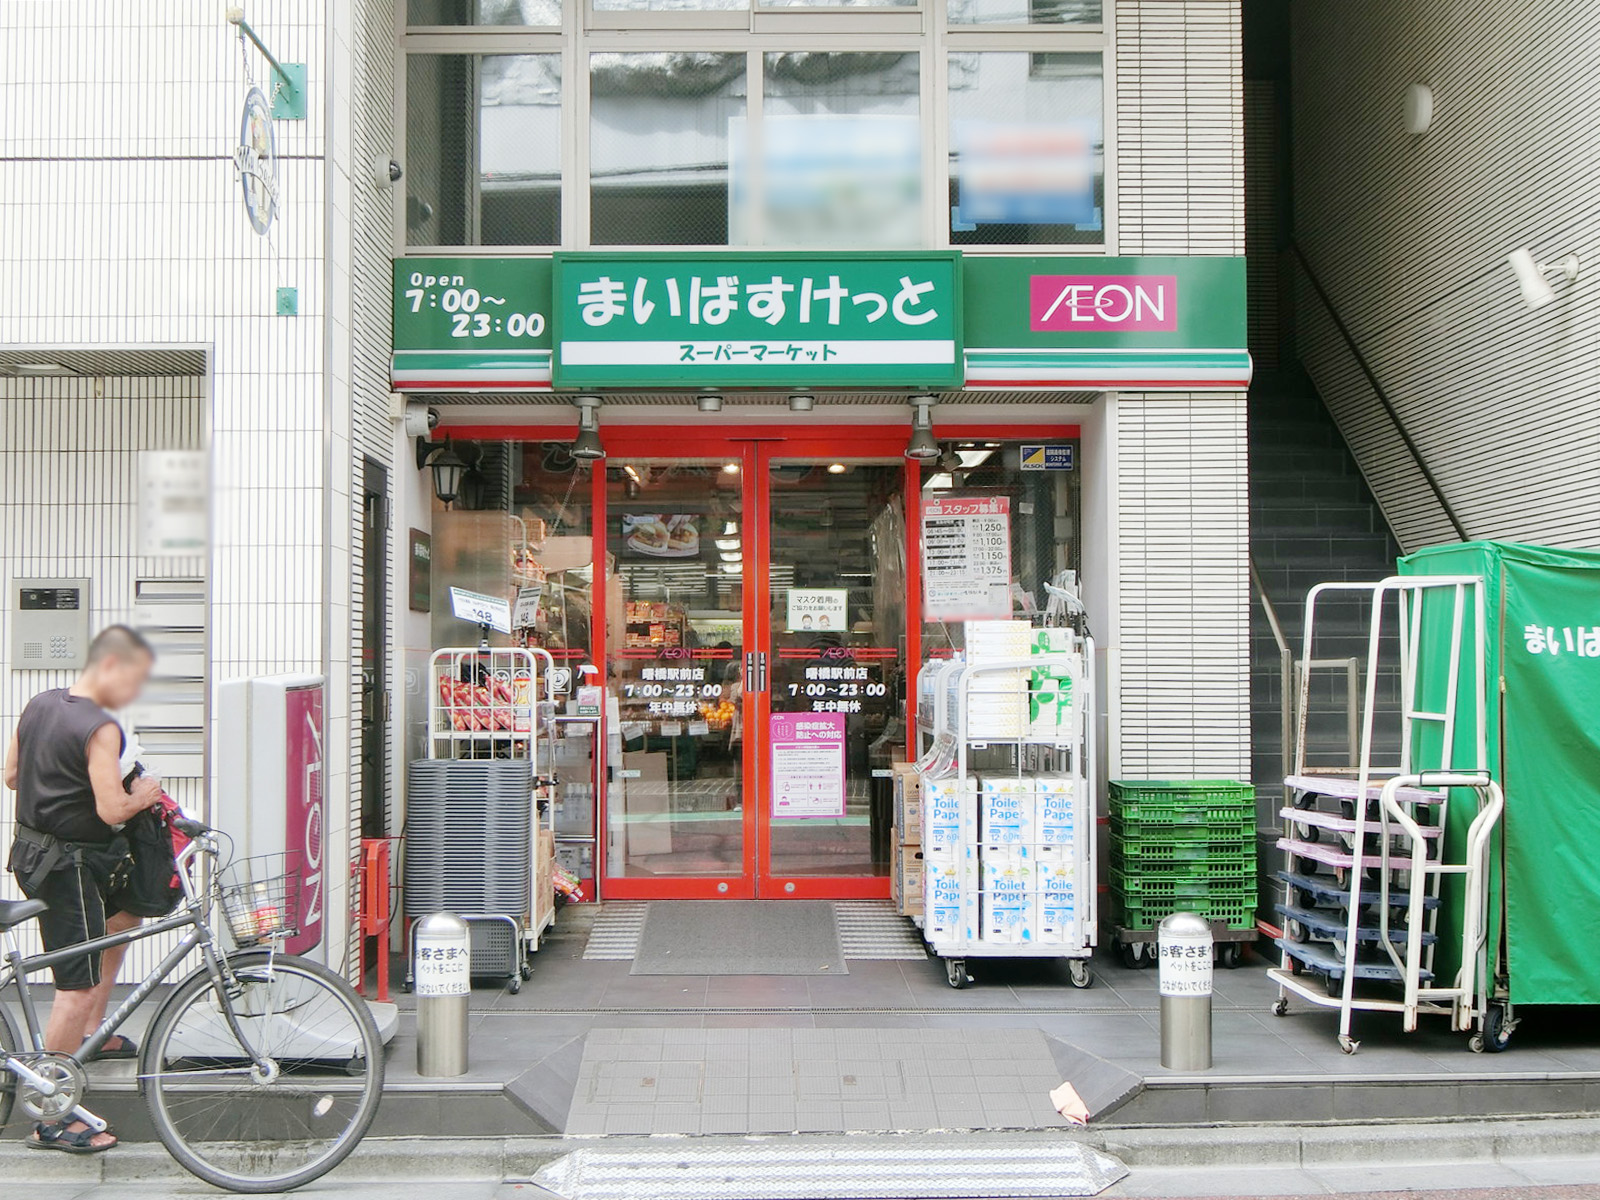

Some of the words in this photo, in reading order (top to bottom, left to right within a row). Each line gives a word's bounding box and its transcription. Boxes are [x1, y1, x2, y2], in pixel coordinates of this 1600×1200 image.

[410, 272, 464, 288] Open
[577, 275, 939, 326] まいばすけっと
[451, 313, 545, 337] 23:00
[679, 344, 838, 362] スーパーマーケット
[649, 701, 698, 714] 年中無休
[812, 700, 861, 713] 年中無休
[993, 879, 1026, 890] Toilet
